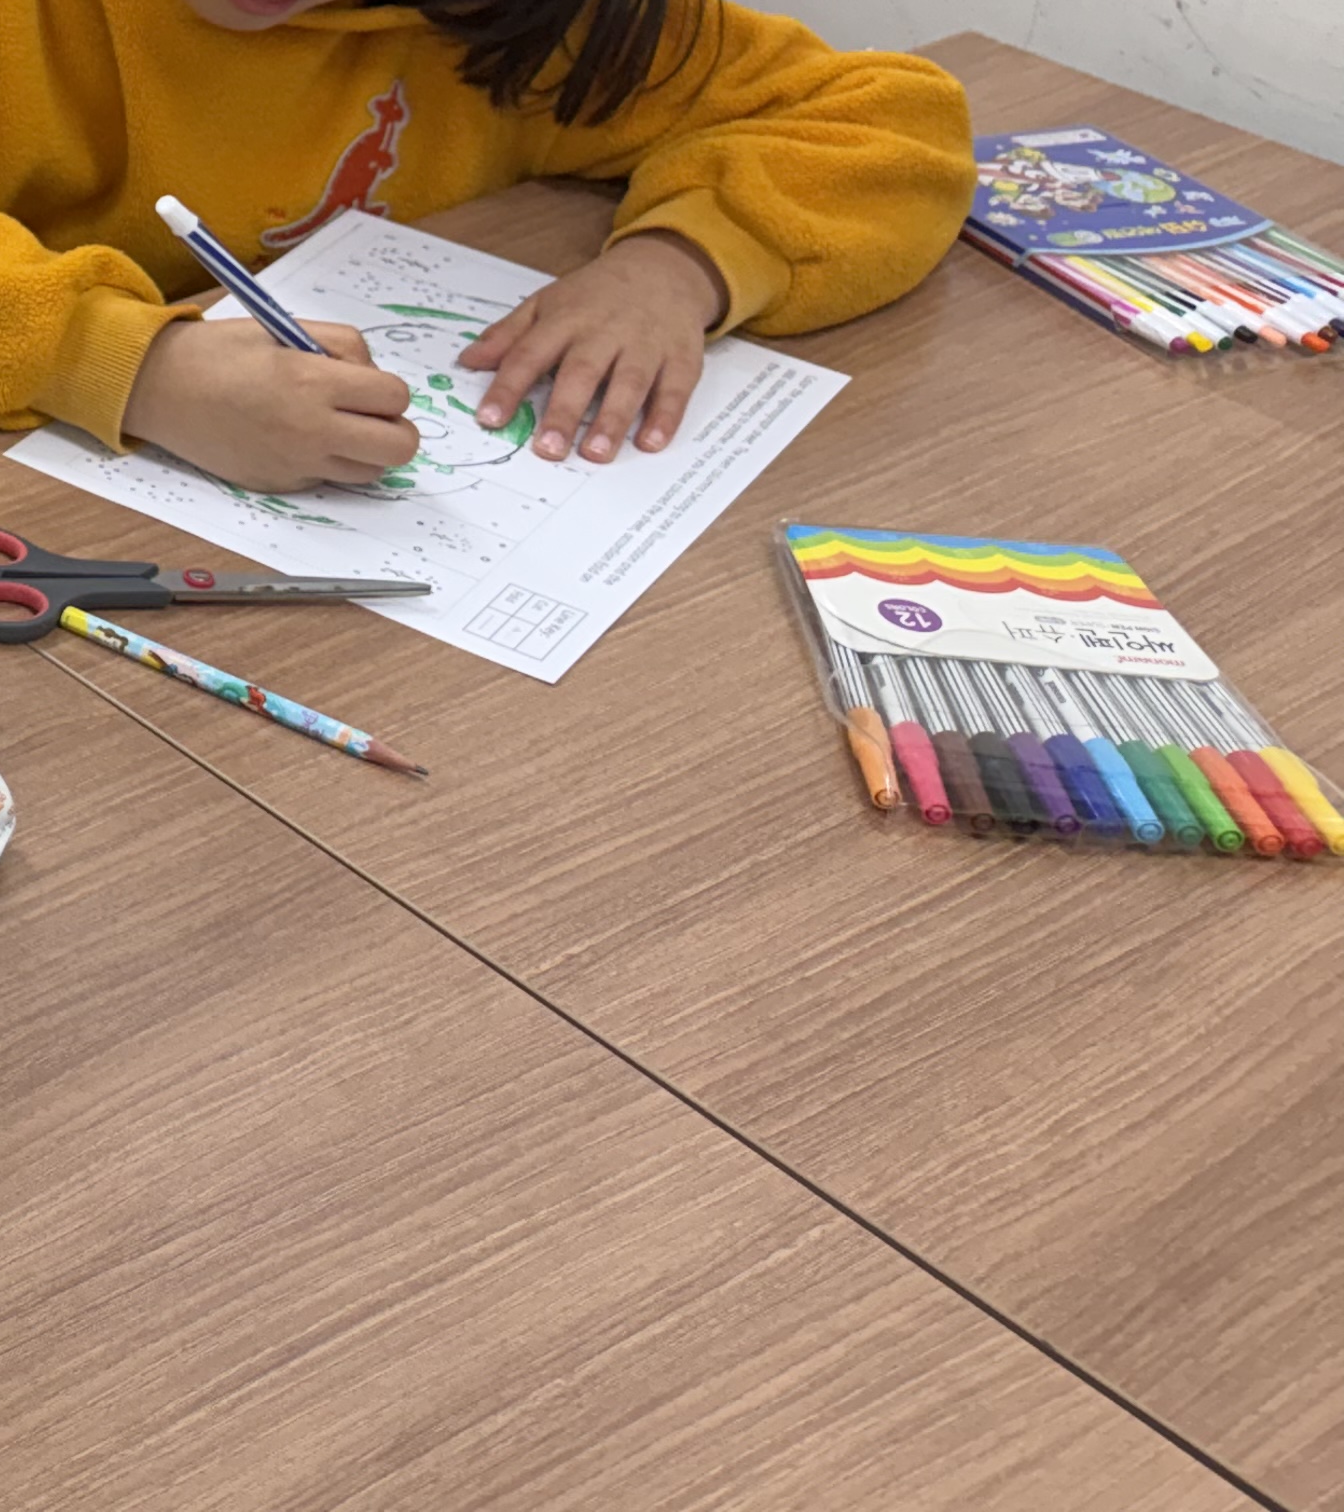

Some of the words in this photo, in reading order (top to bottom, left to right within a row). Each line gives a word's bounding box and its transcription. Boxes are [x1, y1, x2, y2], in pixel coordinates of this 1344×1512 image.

[895, 611, 932, 629] 12
[1002, 620, 1065, 643] 슈퍼
[1075, 628, 1177, 654] 싸인펜
